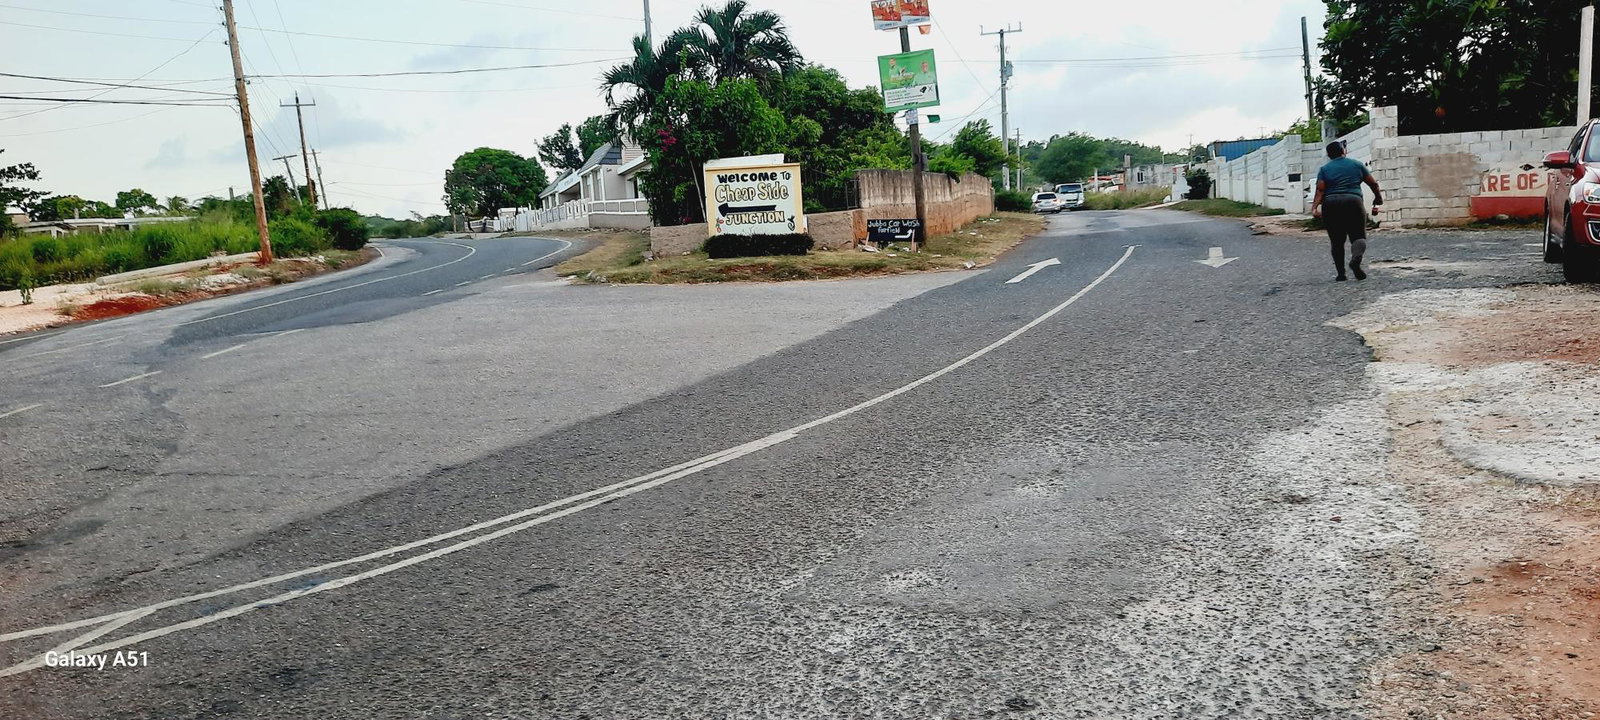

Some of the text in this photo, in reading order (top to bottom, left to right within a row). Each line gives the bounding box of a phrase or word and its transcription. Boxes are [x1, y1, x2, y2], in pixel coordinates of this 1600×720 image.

[1517, 172, 1539, 190] OF
[715, 181, 789, 203] Cheap Side
[726, 211, 785, 225] JUNCTION
